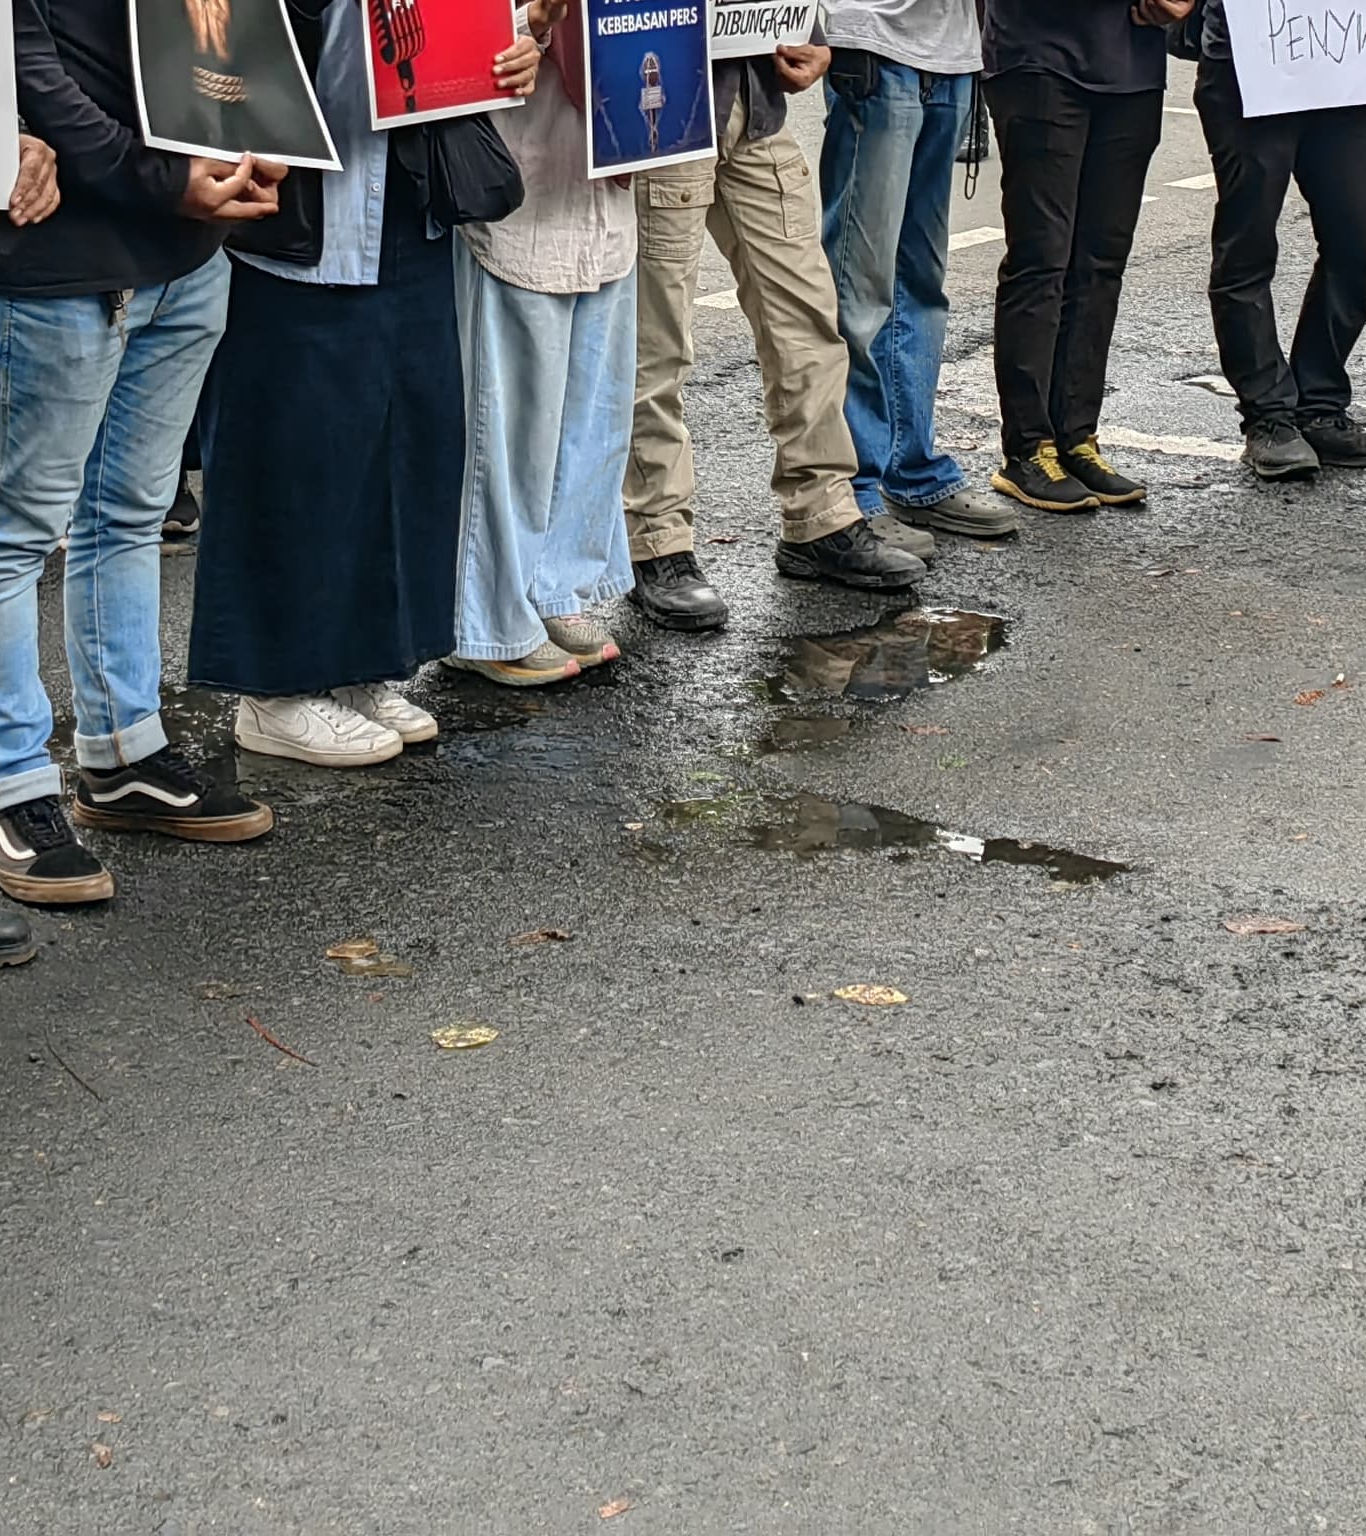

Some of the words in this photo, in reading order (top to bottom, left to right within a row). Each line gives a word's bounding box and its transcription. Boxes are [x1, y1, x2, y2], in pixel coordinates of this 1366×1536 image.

[597, 10, 668, 36] KEBEBASAN
[670, 6, 698, 27] PERS
[712, 4, 810, 40] DIBUNGKAM
